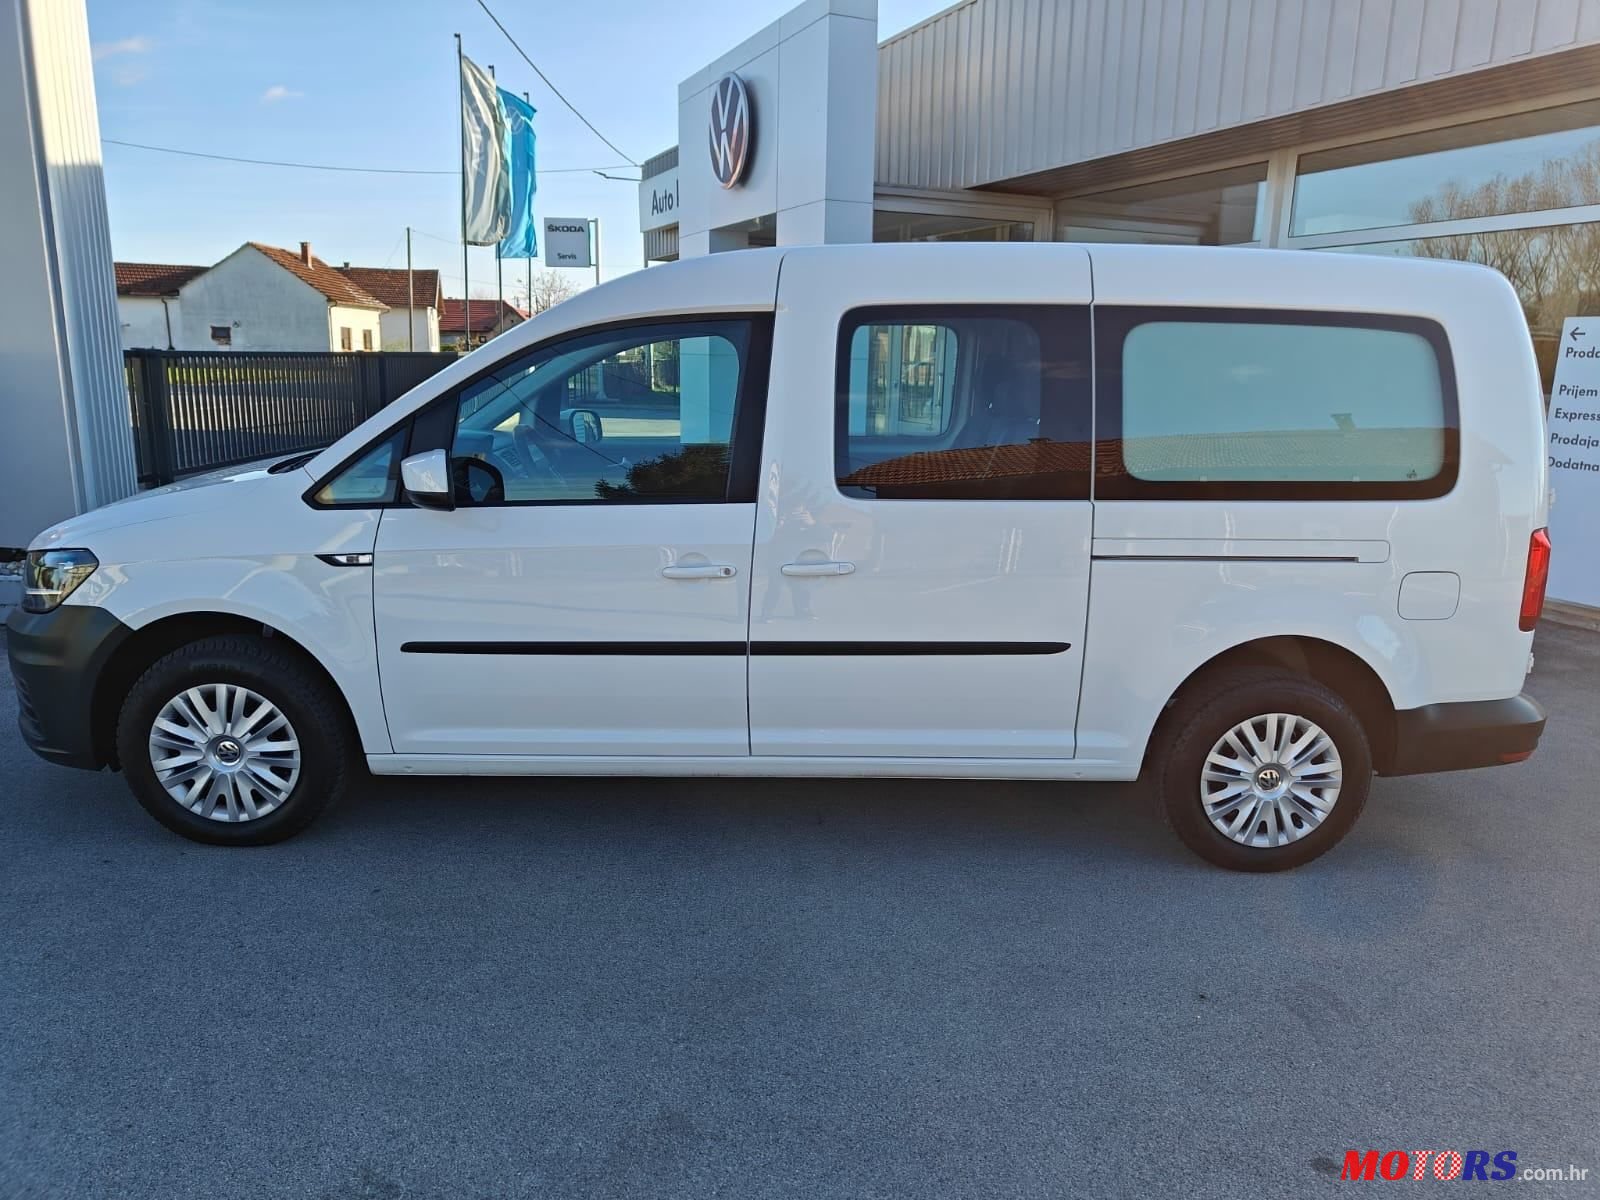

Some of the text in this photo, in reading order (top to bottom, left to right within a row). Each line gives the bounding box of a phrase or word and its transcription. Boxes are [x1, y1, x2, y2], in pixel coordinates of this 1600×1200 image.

[652, 188, 673, 216] Auto
[557, 251, 577, 261] Servis
[1558, 384, 1598, 399] Prijem
[1554, 408, 1600, 422] Express
[1550, 433, 1599, 449] Prodaja
